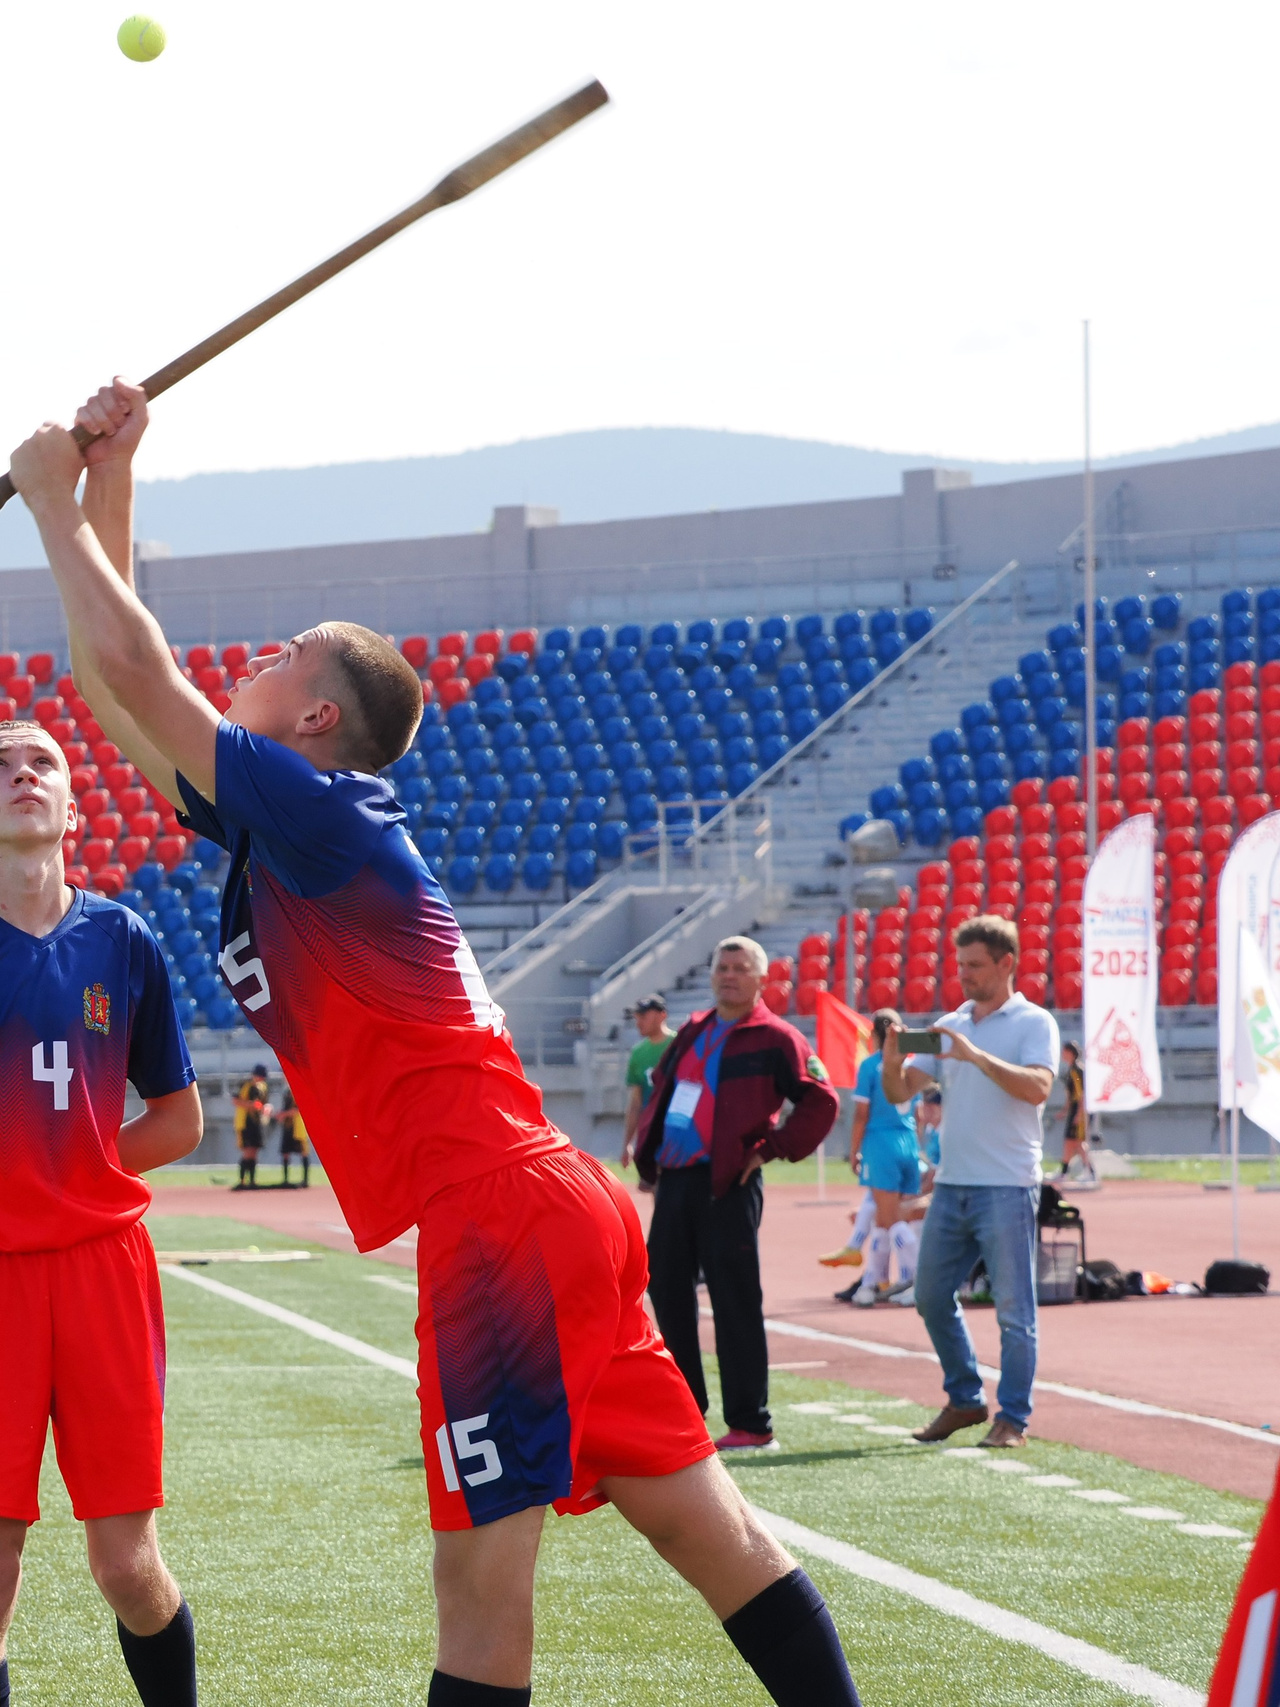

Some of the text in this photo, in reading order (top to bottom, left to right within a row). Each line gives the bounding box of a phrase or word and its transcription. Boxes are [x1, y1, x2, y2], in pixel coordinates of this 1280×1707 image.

[218, 930, 271, 1012] 5
[32, 1040, 74, 1111] 4
[435, 1413, 503, 1493] 15
